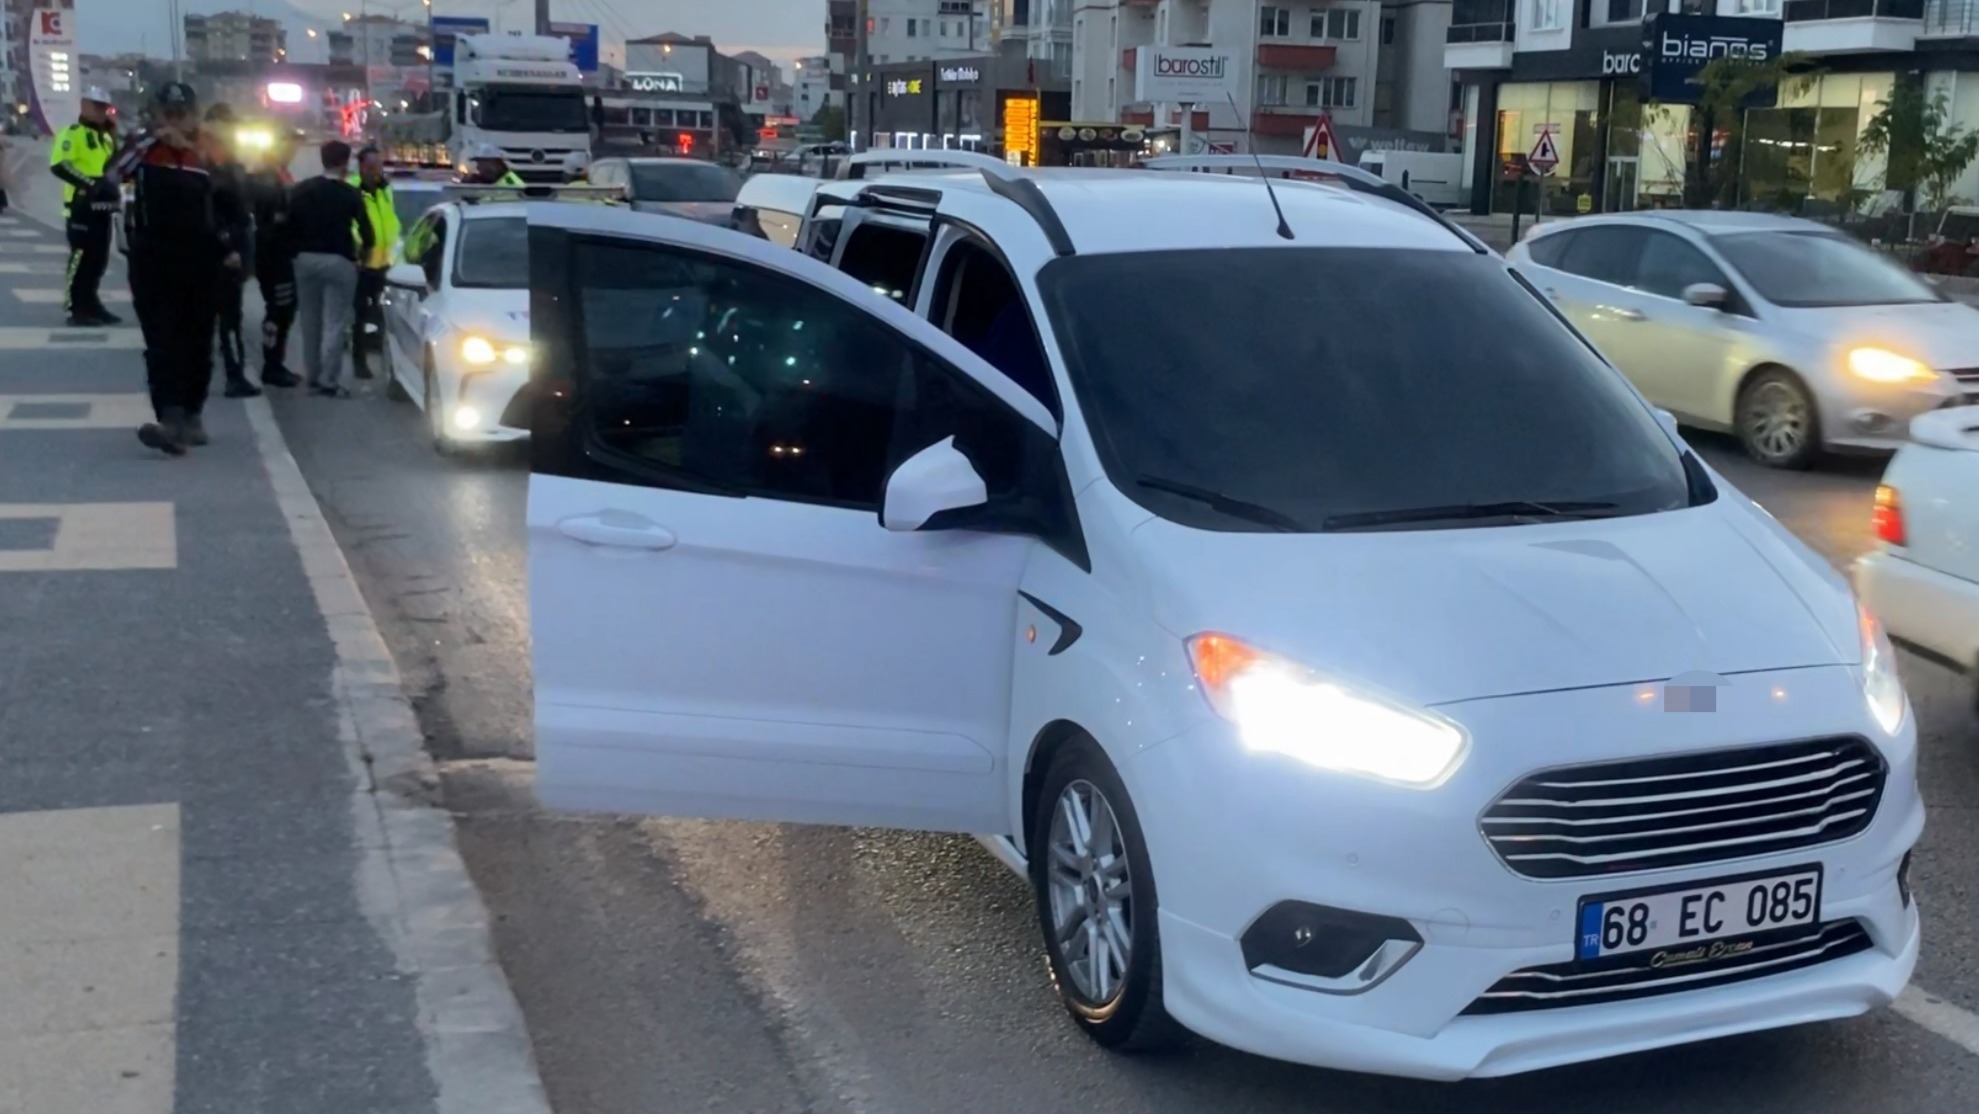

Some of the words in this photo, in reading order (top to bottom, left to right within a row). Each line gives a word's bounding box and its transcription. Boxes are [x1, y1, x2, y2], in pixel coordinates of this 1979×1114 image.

[1602, 902, 1649, 949] 68
[1679, 891, 1726, 937] EC
[1746, 878, 1814, 927] 085
[1583, 933, 1600, 947] TR
